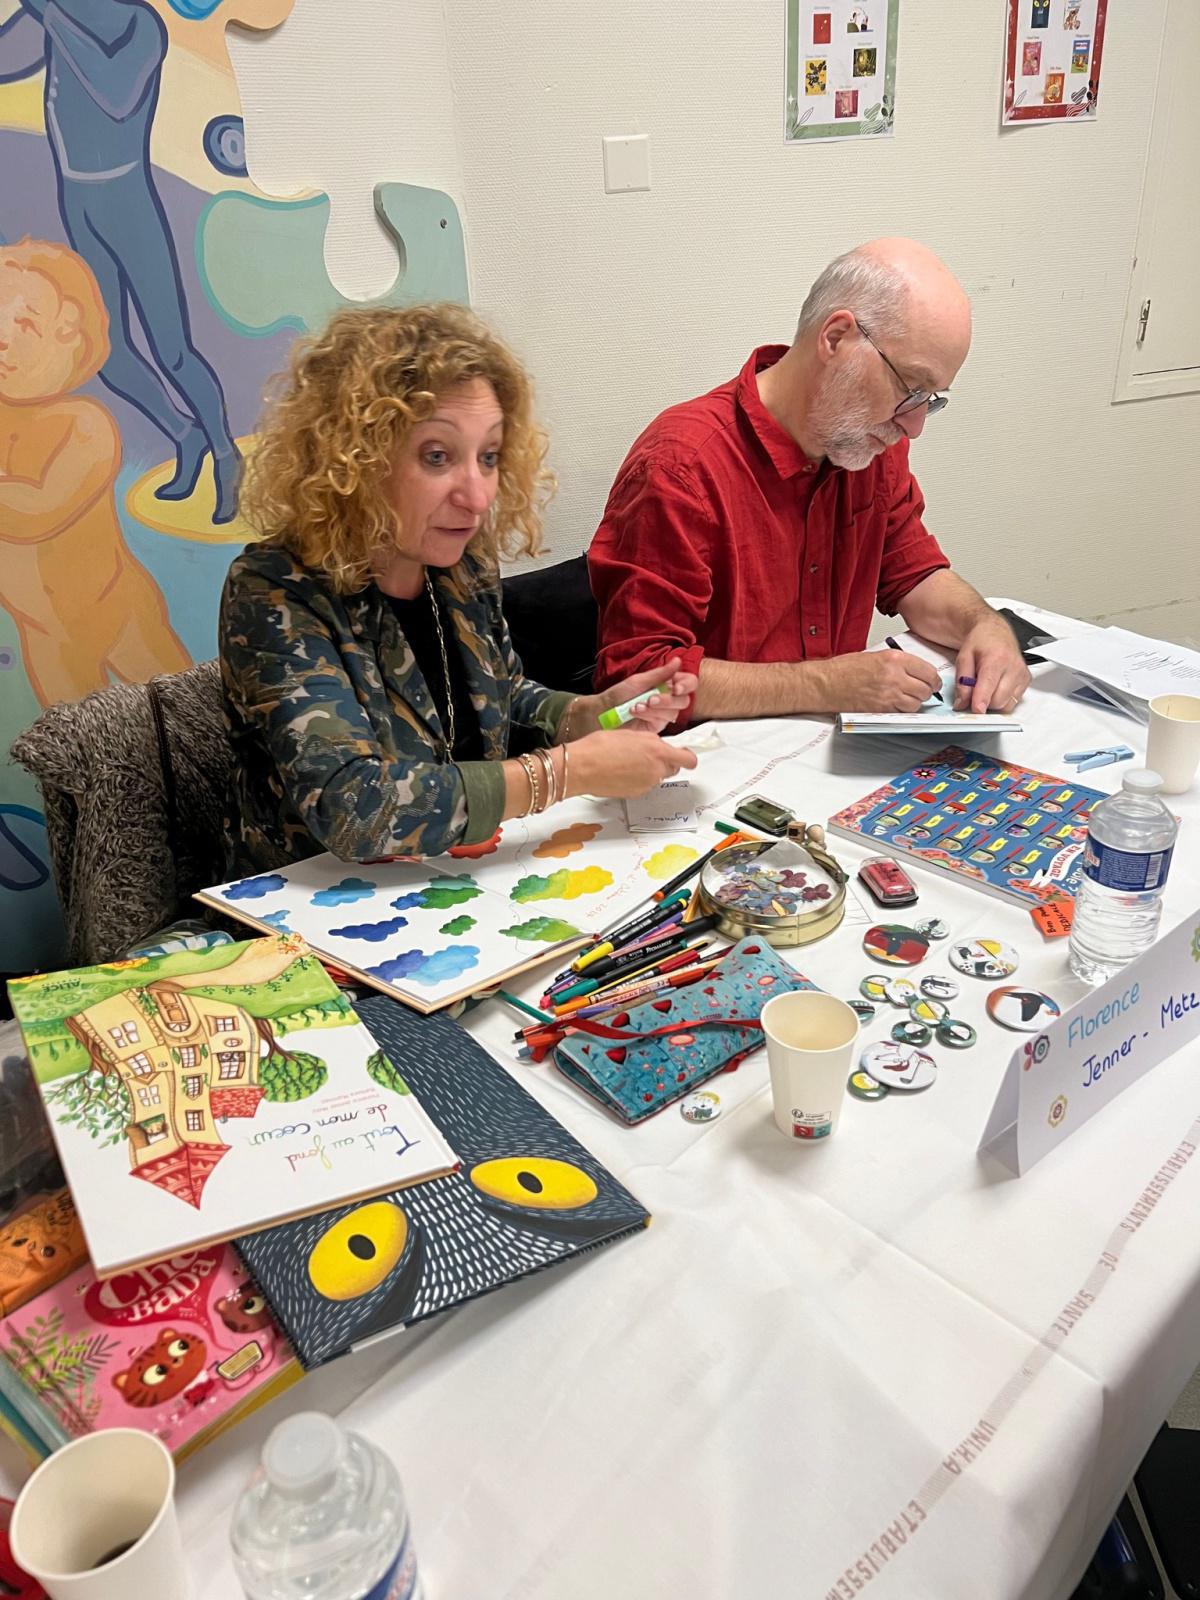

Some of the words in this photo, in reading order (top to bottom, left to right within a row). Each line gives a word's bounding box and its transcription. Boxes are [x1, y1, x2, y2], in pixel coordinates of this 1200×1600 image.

[1068, 845, 1082, 855] EN
[1050, 852, 1071, 878] VOYAGE
[43, 980, 80, 993] ALICE
[1067, 982, 1140, 1048] Florence
[1082, 1034, 1136, 1087] Jenner
[1160, 992, 1200, 1029] Metz
[315, 1110, 359, 1128] mon
[367, 1103, 388, 1123] de
[285, 1135, 332, 1172] fond
[331, 1137, 355, 1150] au
[360, 1125, 421, 1156] Tout
[1119, 1140, 1197, 1233] ETABLISSEMENTS
[1098, 1250, 1119, 1273] DE
[1051, 1288, 1096, 1336] SANTE
